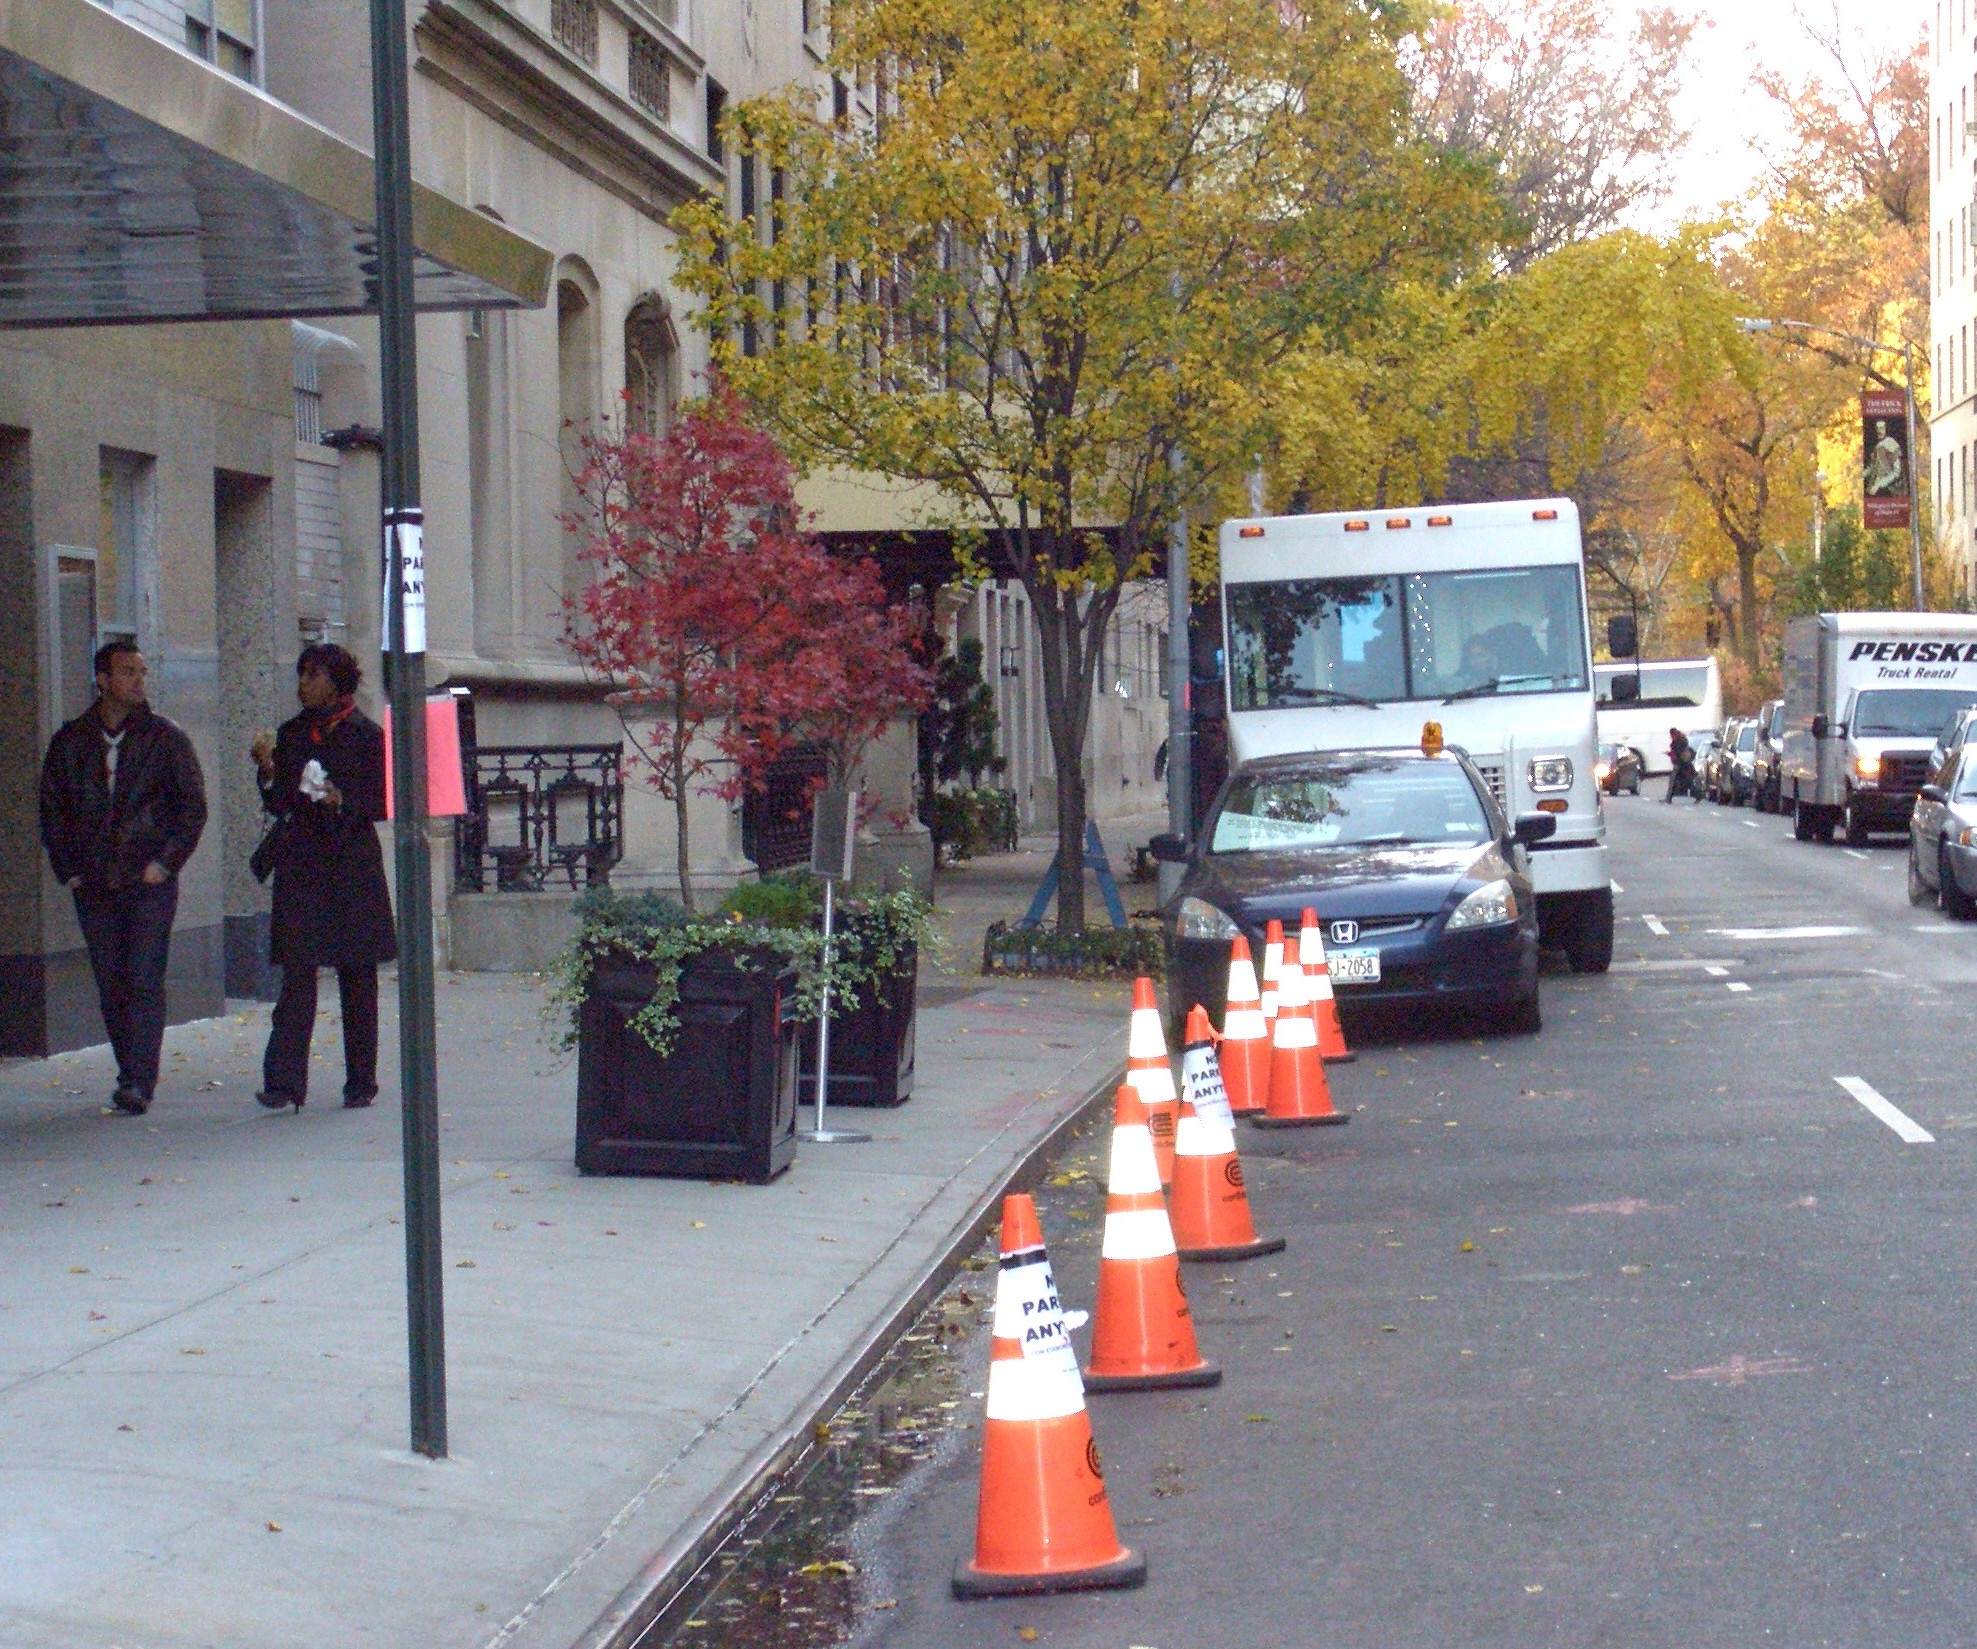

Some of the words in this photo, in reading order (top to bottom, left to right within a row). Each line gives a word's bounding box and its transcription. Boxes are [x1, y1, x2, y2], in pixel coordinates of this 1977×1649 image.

[1848, 642, 1977, 662] PENSKE
[1877, 667, 1910, 679] Truck
[1914, 667, 1958, 679] Rental
[1026, 1320, 1065, 1343] ANY
